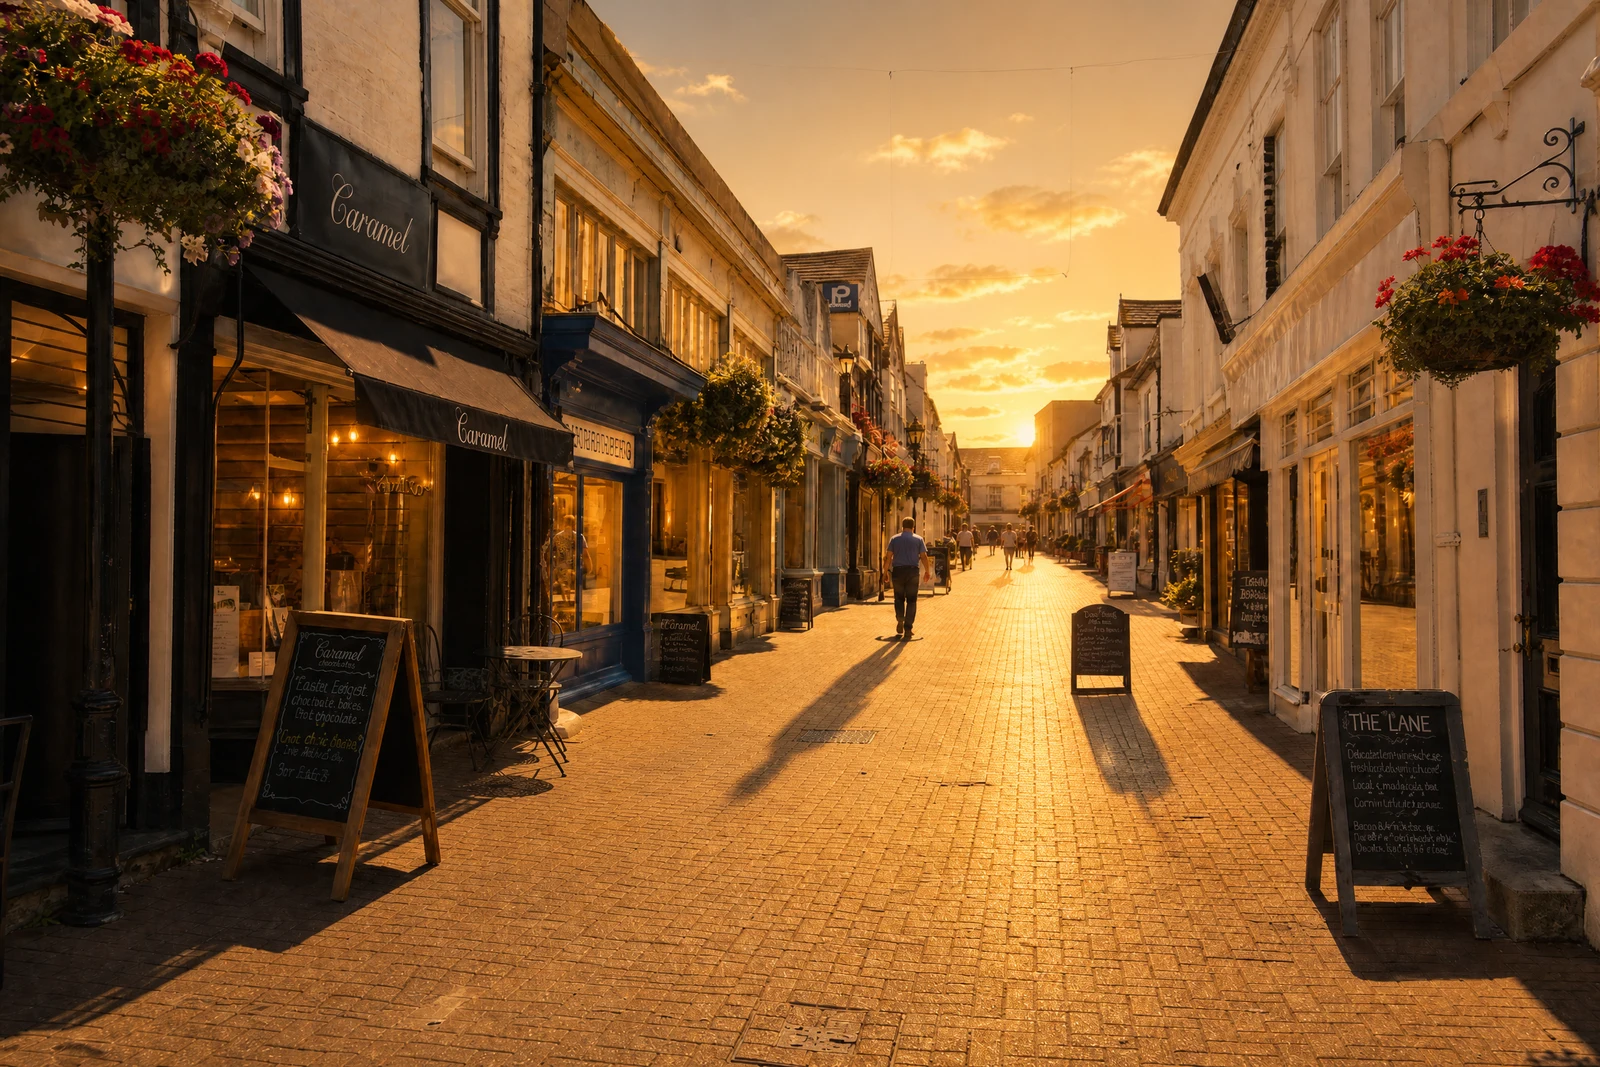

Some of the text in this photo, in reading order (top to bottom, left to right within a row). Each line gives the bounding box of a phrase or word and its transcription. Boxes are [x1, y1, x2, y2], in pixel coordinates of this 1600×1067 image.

[330, 173, 413, 254] Caramel
[455, 407, 508, 451] Caramel
[315, 638, 366, 661] Caramel
[1349, 712, 1431, 732] THE LANE
